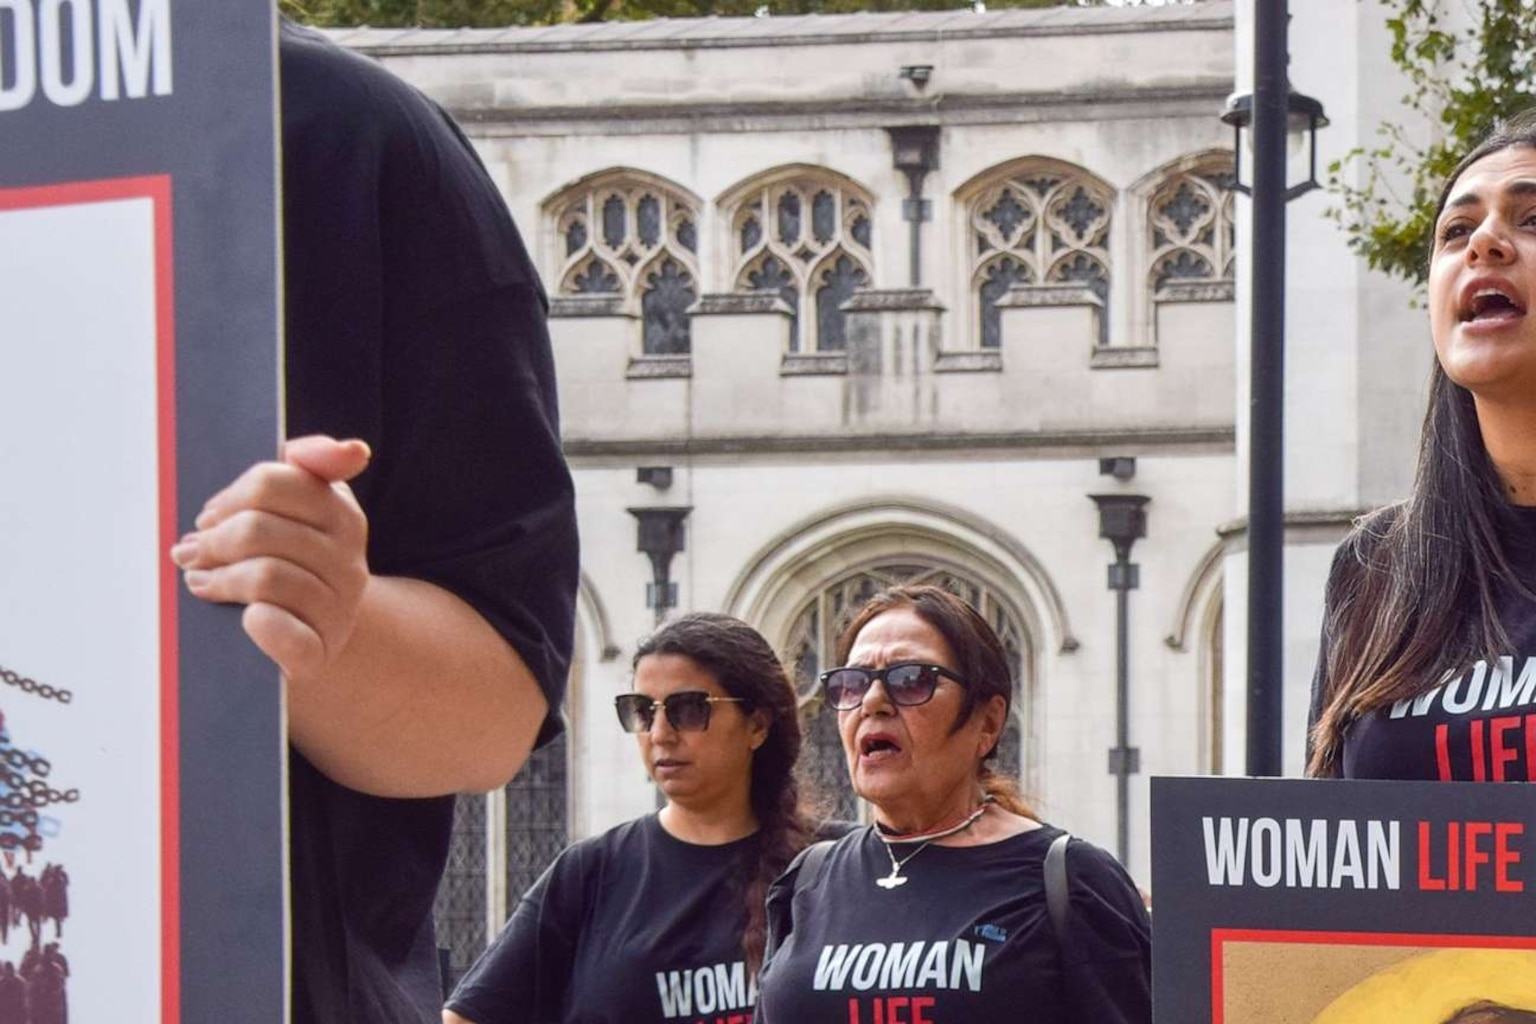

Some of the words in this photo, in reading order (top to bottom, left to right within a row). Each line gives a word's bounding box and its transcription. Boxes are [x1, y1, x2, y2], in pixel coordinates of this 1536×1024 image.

[1202, 817, 1400, 890] WOMAN
[1418, 821, 1524, 892] LIFE
[813, 938, 985, 992] WOMAN
